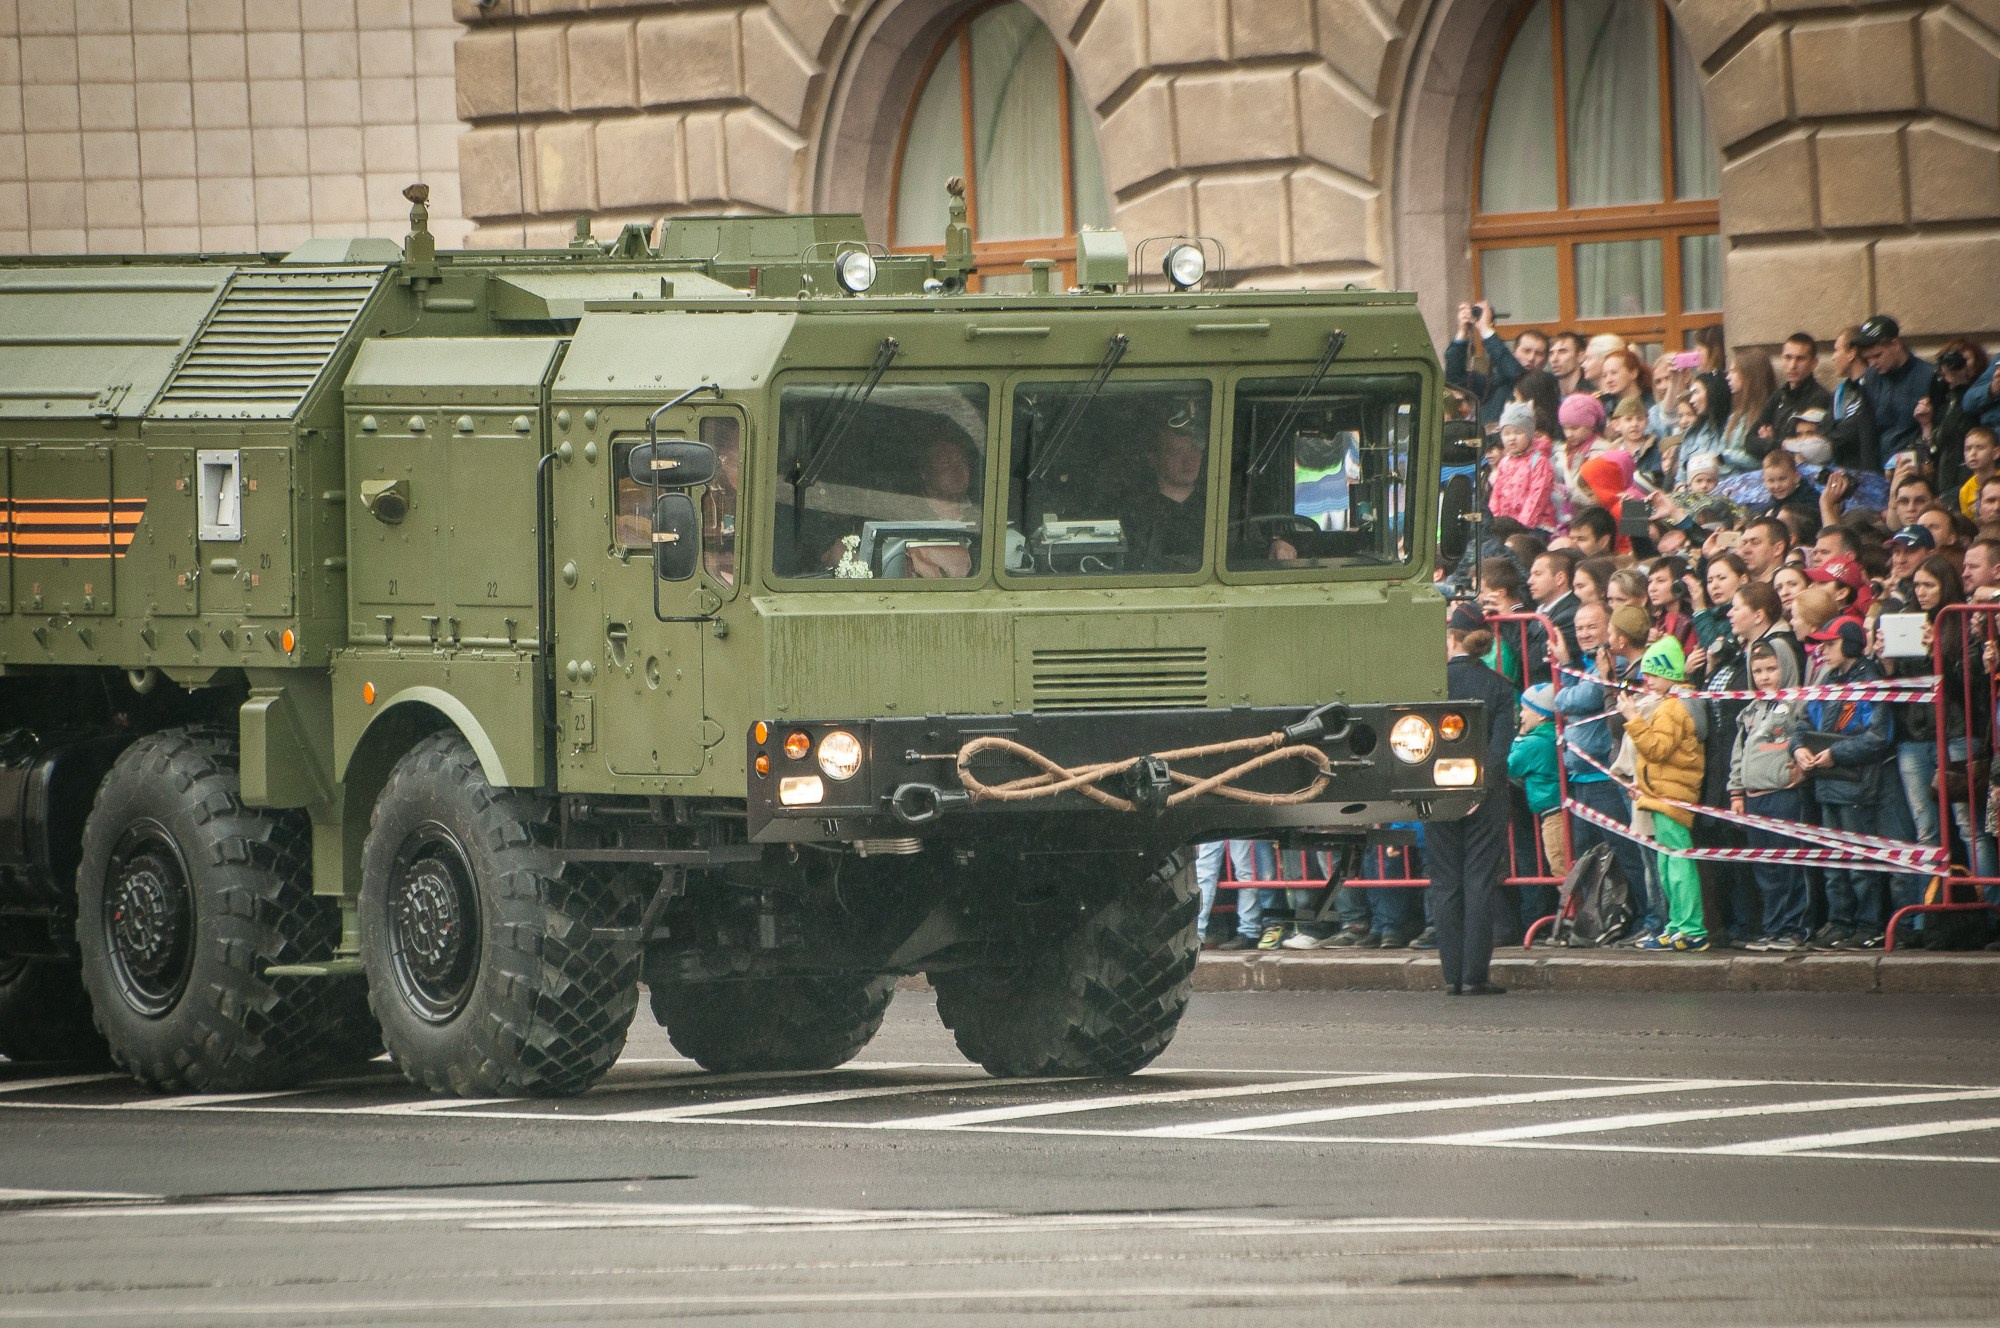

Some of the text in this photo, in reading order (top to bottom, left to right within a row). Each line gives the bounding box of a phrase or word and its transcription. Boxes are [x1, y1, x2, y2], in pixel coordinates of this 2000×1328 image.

[260, 553, 271, 569] 20
[389, 579, 398, 596] 21
[487, 582, 498, 598] 22
[575, 714, 586, 730] 23
